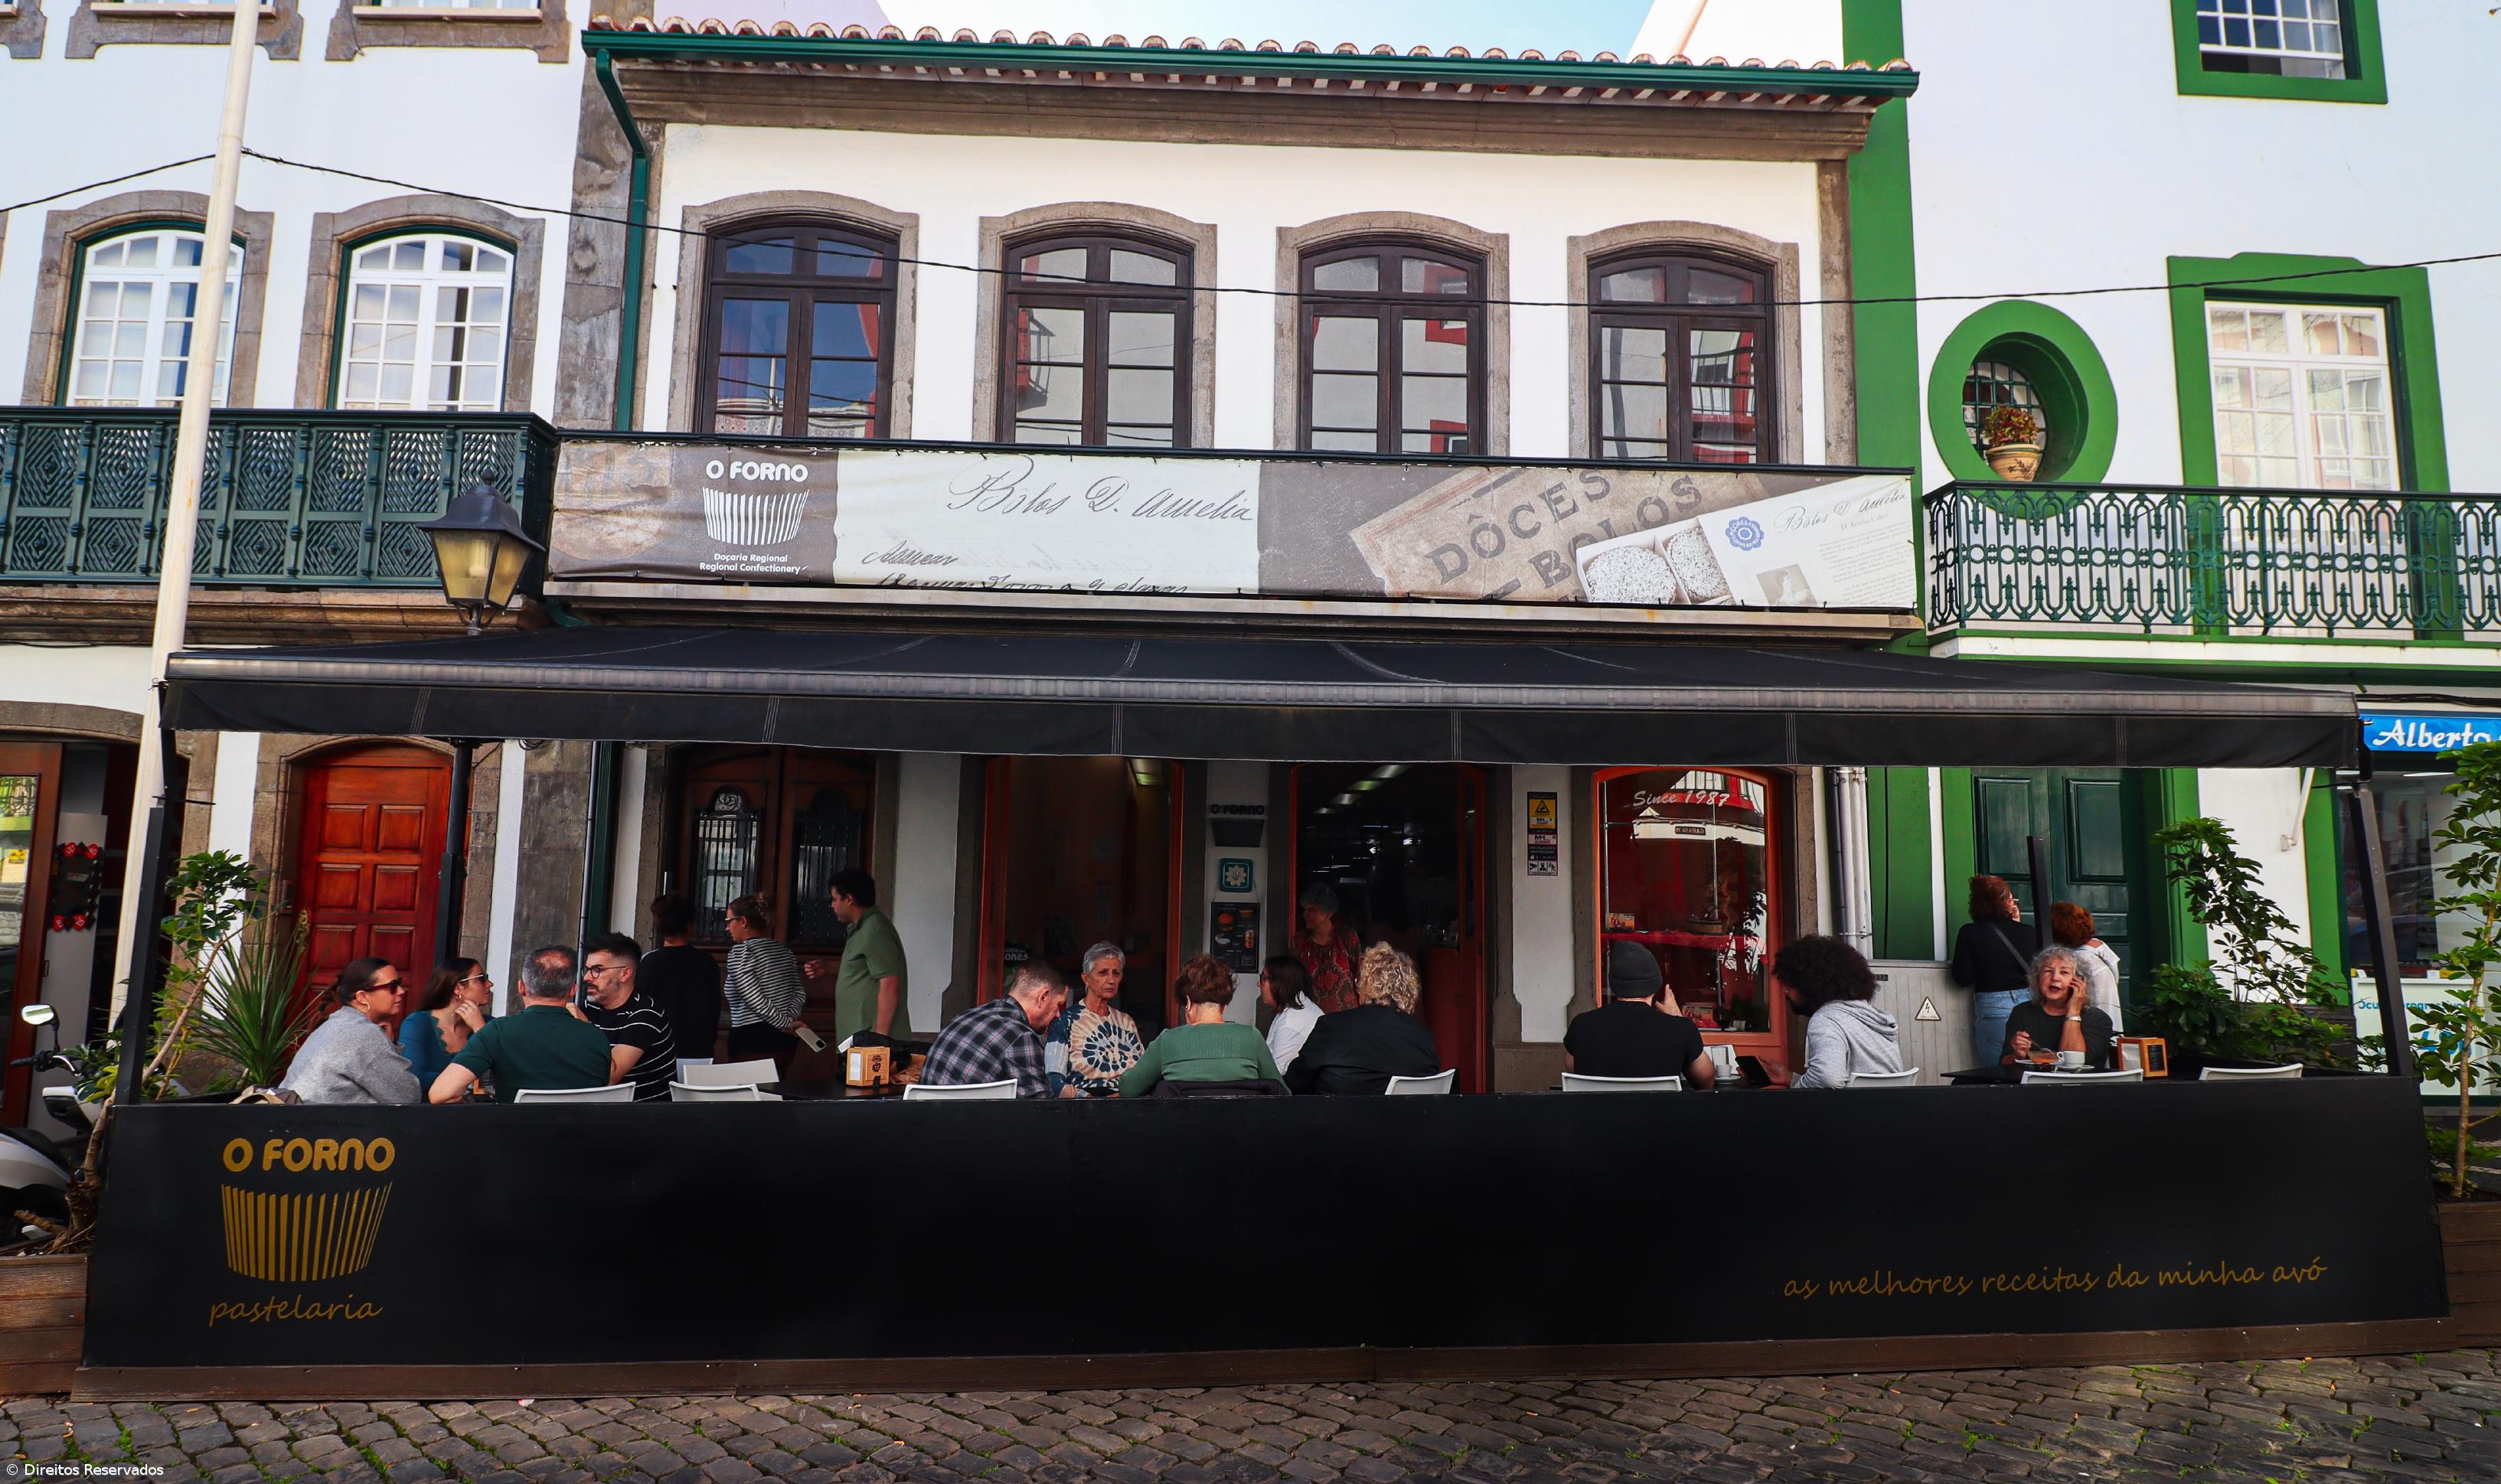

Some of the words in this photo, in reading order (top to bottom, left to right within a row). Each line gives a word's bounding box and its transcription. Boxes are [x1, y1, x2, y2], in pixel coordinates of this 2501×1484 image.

[706, 460, 724, 479] O
[730, 462, 808, 482] FORNO
[1425, 471, 1611, 585] DÔCES
[700, 562, 738, 572] Regional
[740, 563, 801, 575] Confectionery
[713, 553, 748, 563] Doçaria
[750, 553, 789, 563] Regional
[1210, 804, 1220, 814] O
[1223, 804, 1265, 815] FORNO
[1632, 790, 1677, 808] Since
[1684, 791, 1730, 808] 1987
[223, 1137, 253, 1173] O
[263, 1137, 396, 1172] FORNO
[1784, 1278, 1820, 1300] as
[1829, 1270, 1974, 1296] melhores
[1982, 1265, 2101, 1293] receitas
[2107, 1263, 2150, 1289] da
[2158, 1261, 2265, 1287] minha
[2271, 1255, 2329, 1283] avó
[209, 1293, 384, 1328] pastelaria
